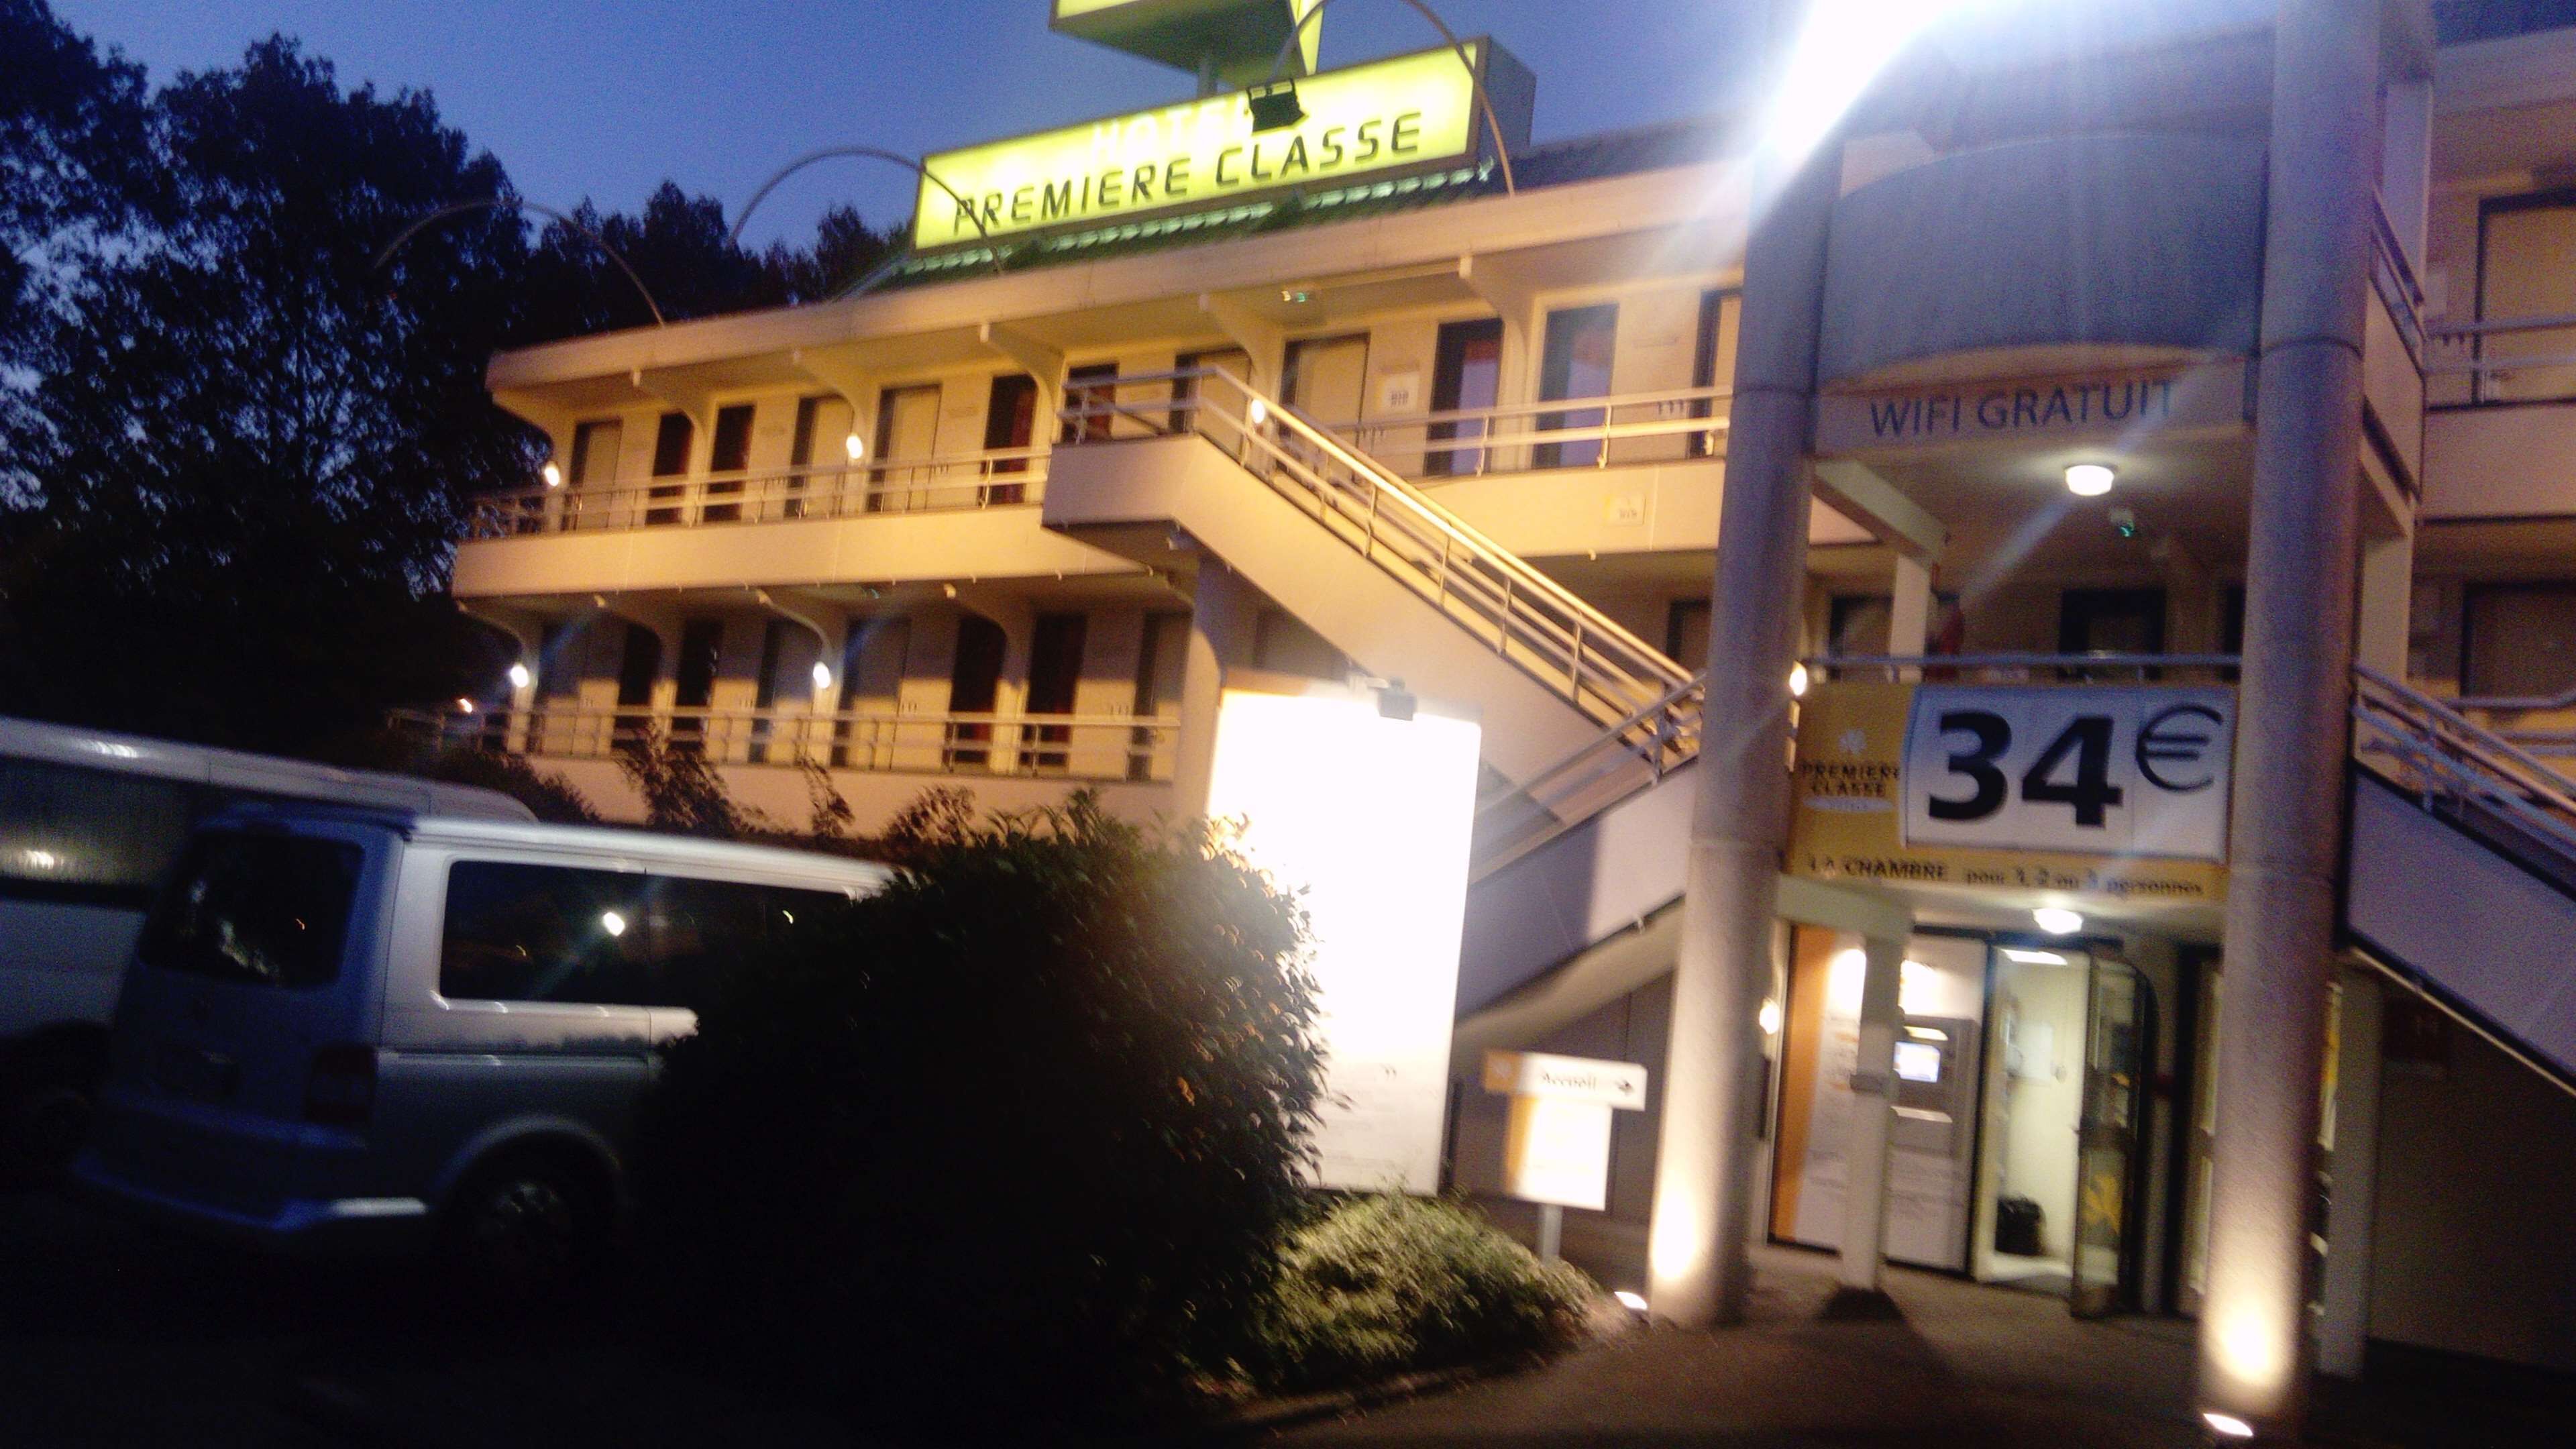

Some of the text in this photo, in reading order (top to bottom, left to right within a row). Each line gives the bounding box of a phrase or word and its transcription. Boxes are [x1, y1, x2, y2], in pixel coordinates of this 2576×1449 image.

[953, 112, 1422, 236] PREMIERE CLASSE
[1870, 378, 2174, 438] WIFI GRATUIT
[1800, 760, 1900, 782] PREMIERE
[1811, 779, 1887, 798] CLASSE
[1842, 855, 1946, 882] CHAMBRE
